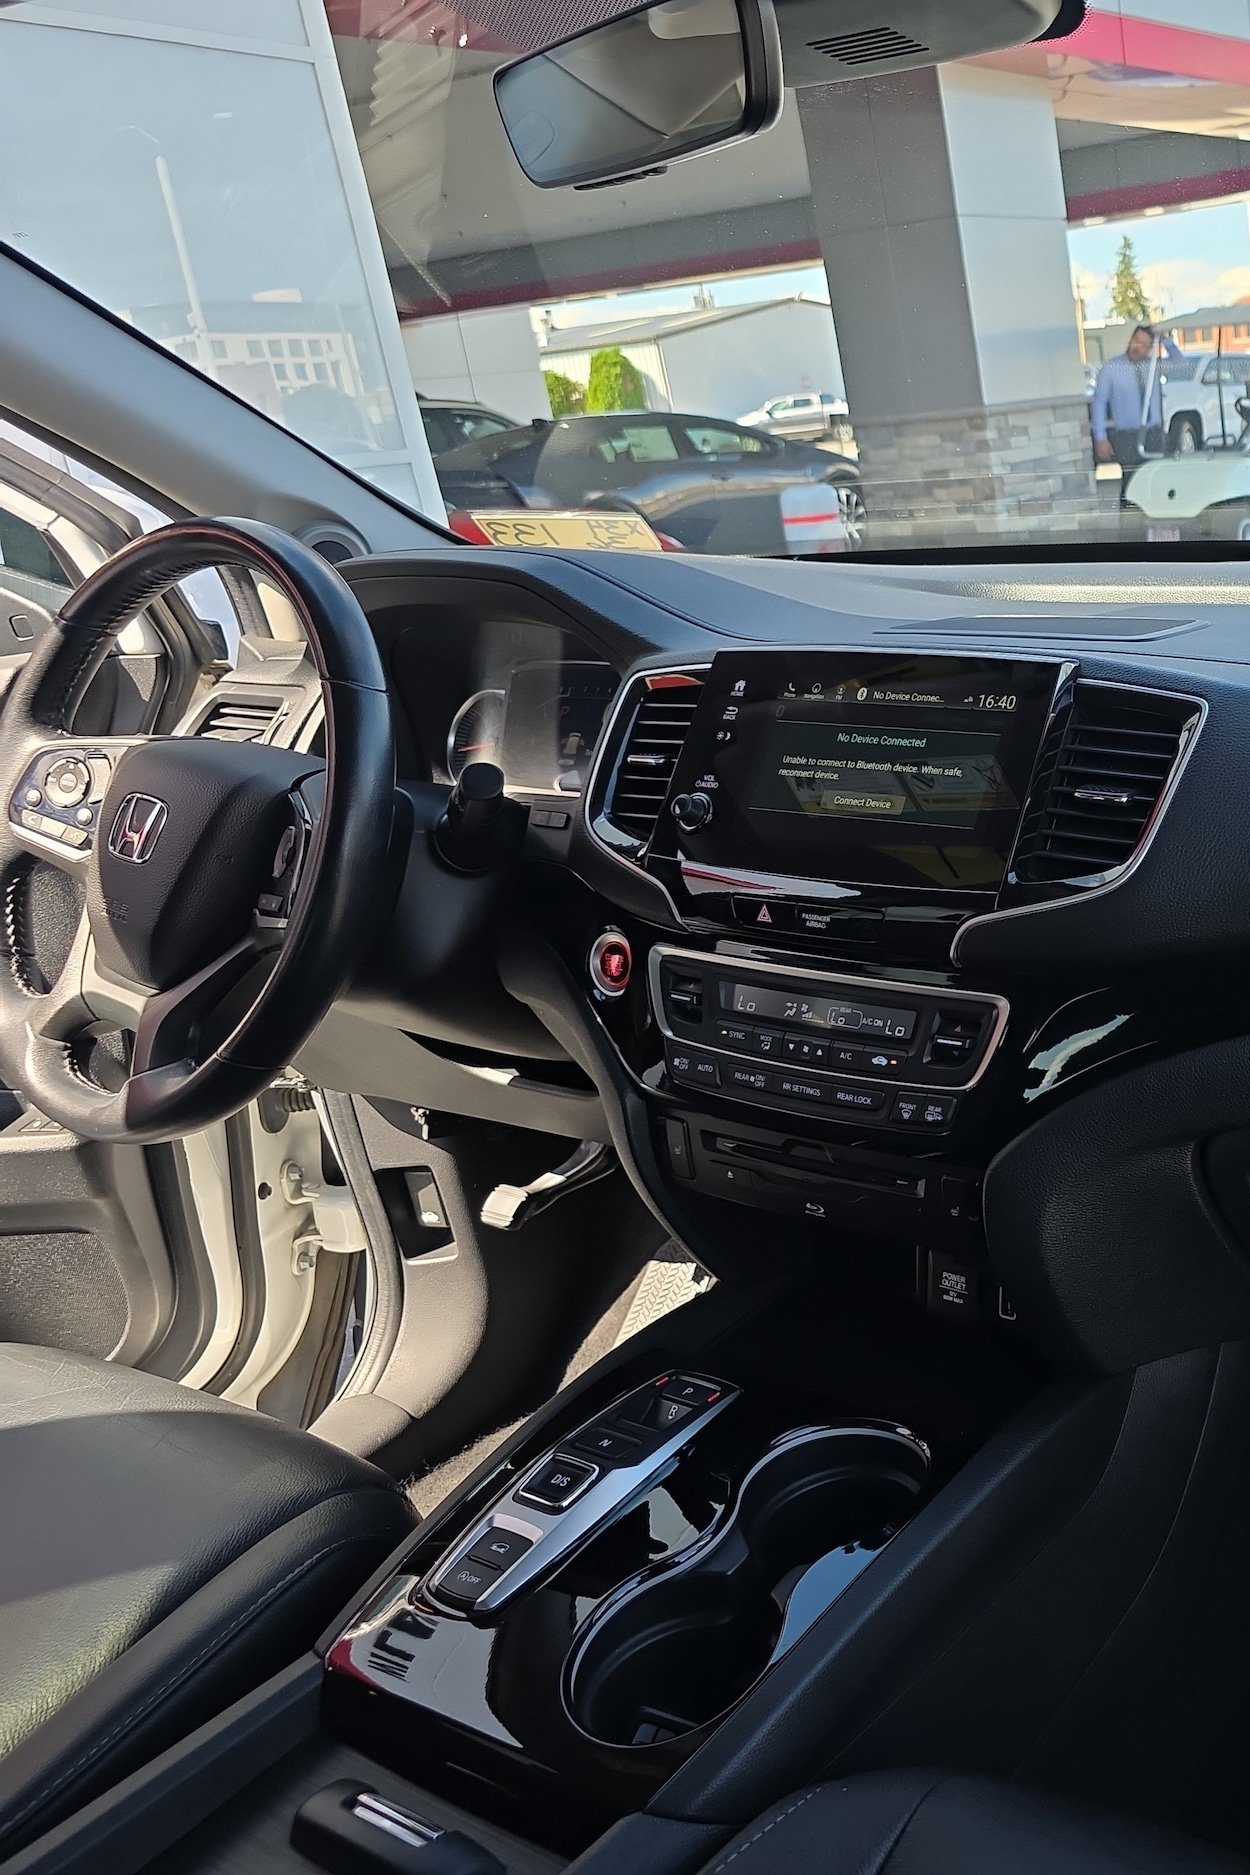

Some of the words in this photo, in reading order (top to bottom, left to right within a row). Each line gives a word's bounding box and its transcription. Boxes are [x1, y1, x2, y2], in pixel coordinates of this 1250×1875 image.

[873, 692, 884, 700] No
[886, 691, 910, 701] Device
[978, 694, 1016, 710] 16:40
[837, 733, 850, 743] No
[851, 734, 880, 745] Device
[880, 736, 927, 748] Connected
[782, 755, 808, 765] Unable
[808, 757, 816, 766] to
[816, 758, 847, 768] connect
[847, 760, 855, 768] to
[856, 760, 892, 772] Bluetooth
[893, 763, 919, 774] device.
[921, 765, 943, 775] When
[944, 767, 964, 778] safe,
[778, 768, 814, 778] reconnect
[814, 770, 840, 780] device.
[834, 796, 866, 807] Connect
[866, 797, 892, 809] Device
[802, 912, 831, 922] PASSENGER
[805, 920, 826, 928] AIRBAG
[729, 1031, 746, 1040] SYNC
[840, 1051, 852, 1061] A/C
[698, 1064, 714, 1072] AUTO
[734, 1072, 750, 1081] REAR
[754, 1080, 766, 1088] OFF
[782, 1082, 792, 1090] RR
[792, 1084, 821, 1097] SETTINGS
[837, 1091, 854, 1102] REAR
[854, 1094, 872, 1105] LOCK
[900, 1102, 917, 1111] FRONT
[928, 1104, 943, 1113] REAR
[942, 1272, 966, 1283] POWER
[942, 1278, 966, 1290] OUTLET
[668, 1404, 678, 1416] R
[598, 1438, 612, 1447] N
[550, 1474, 571, 1486] D/S
[467, 1576, 482, 1584] OFF
